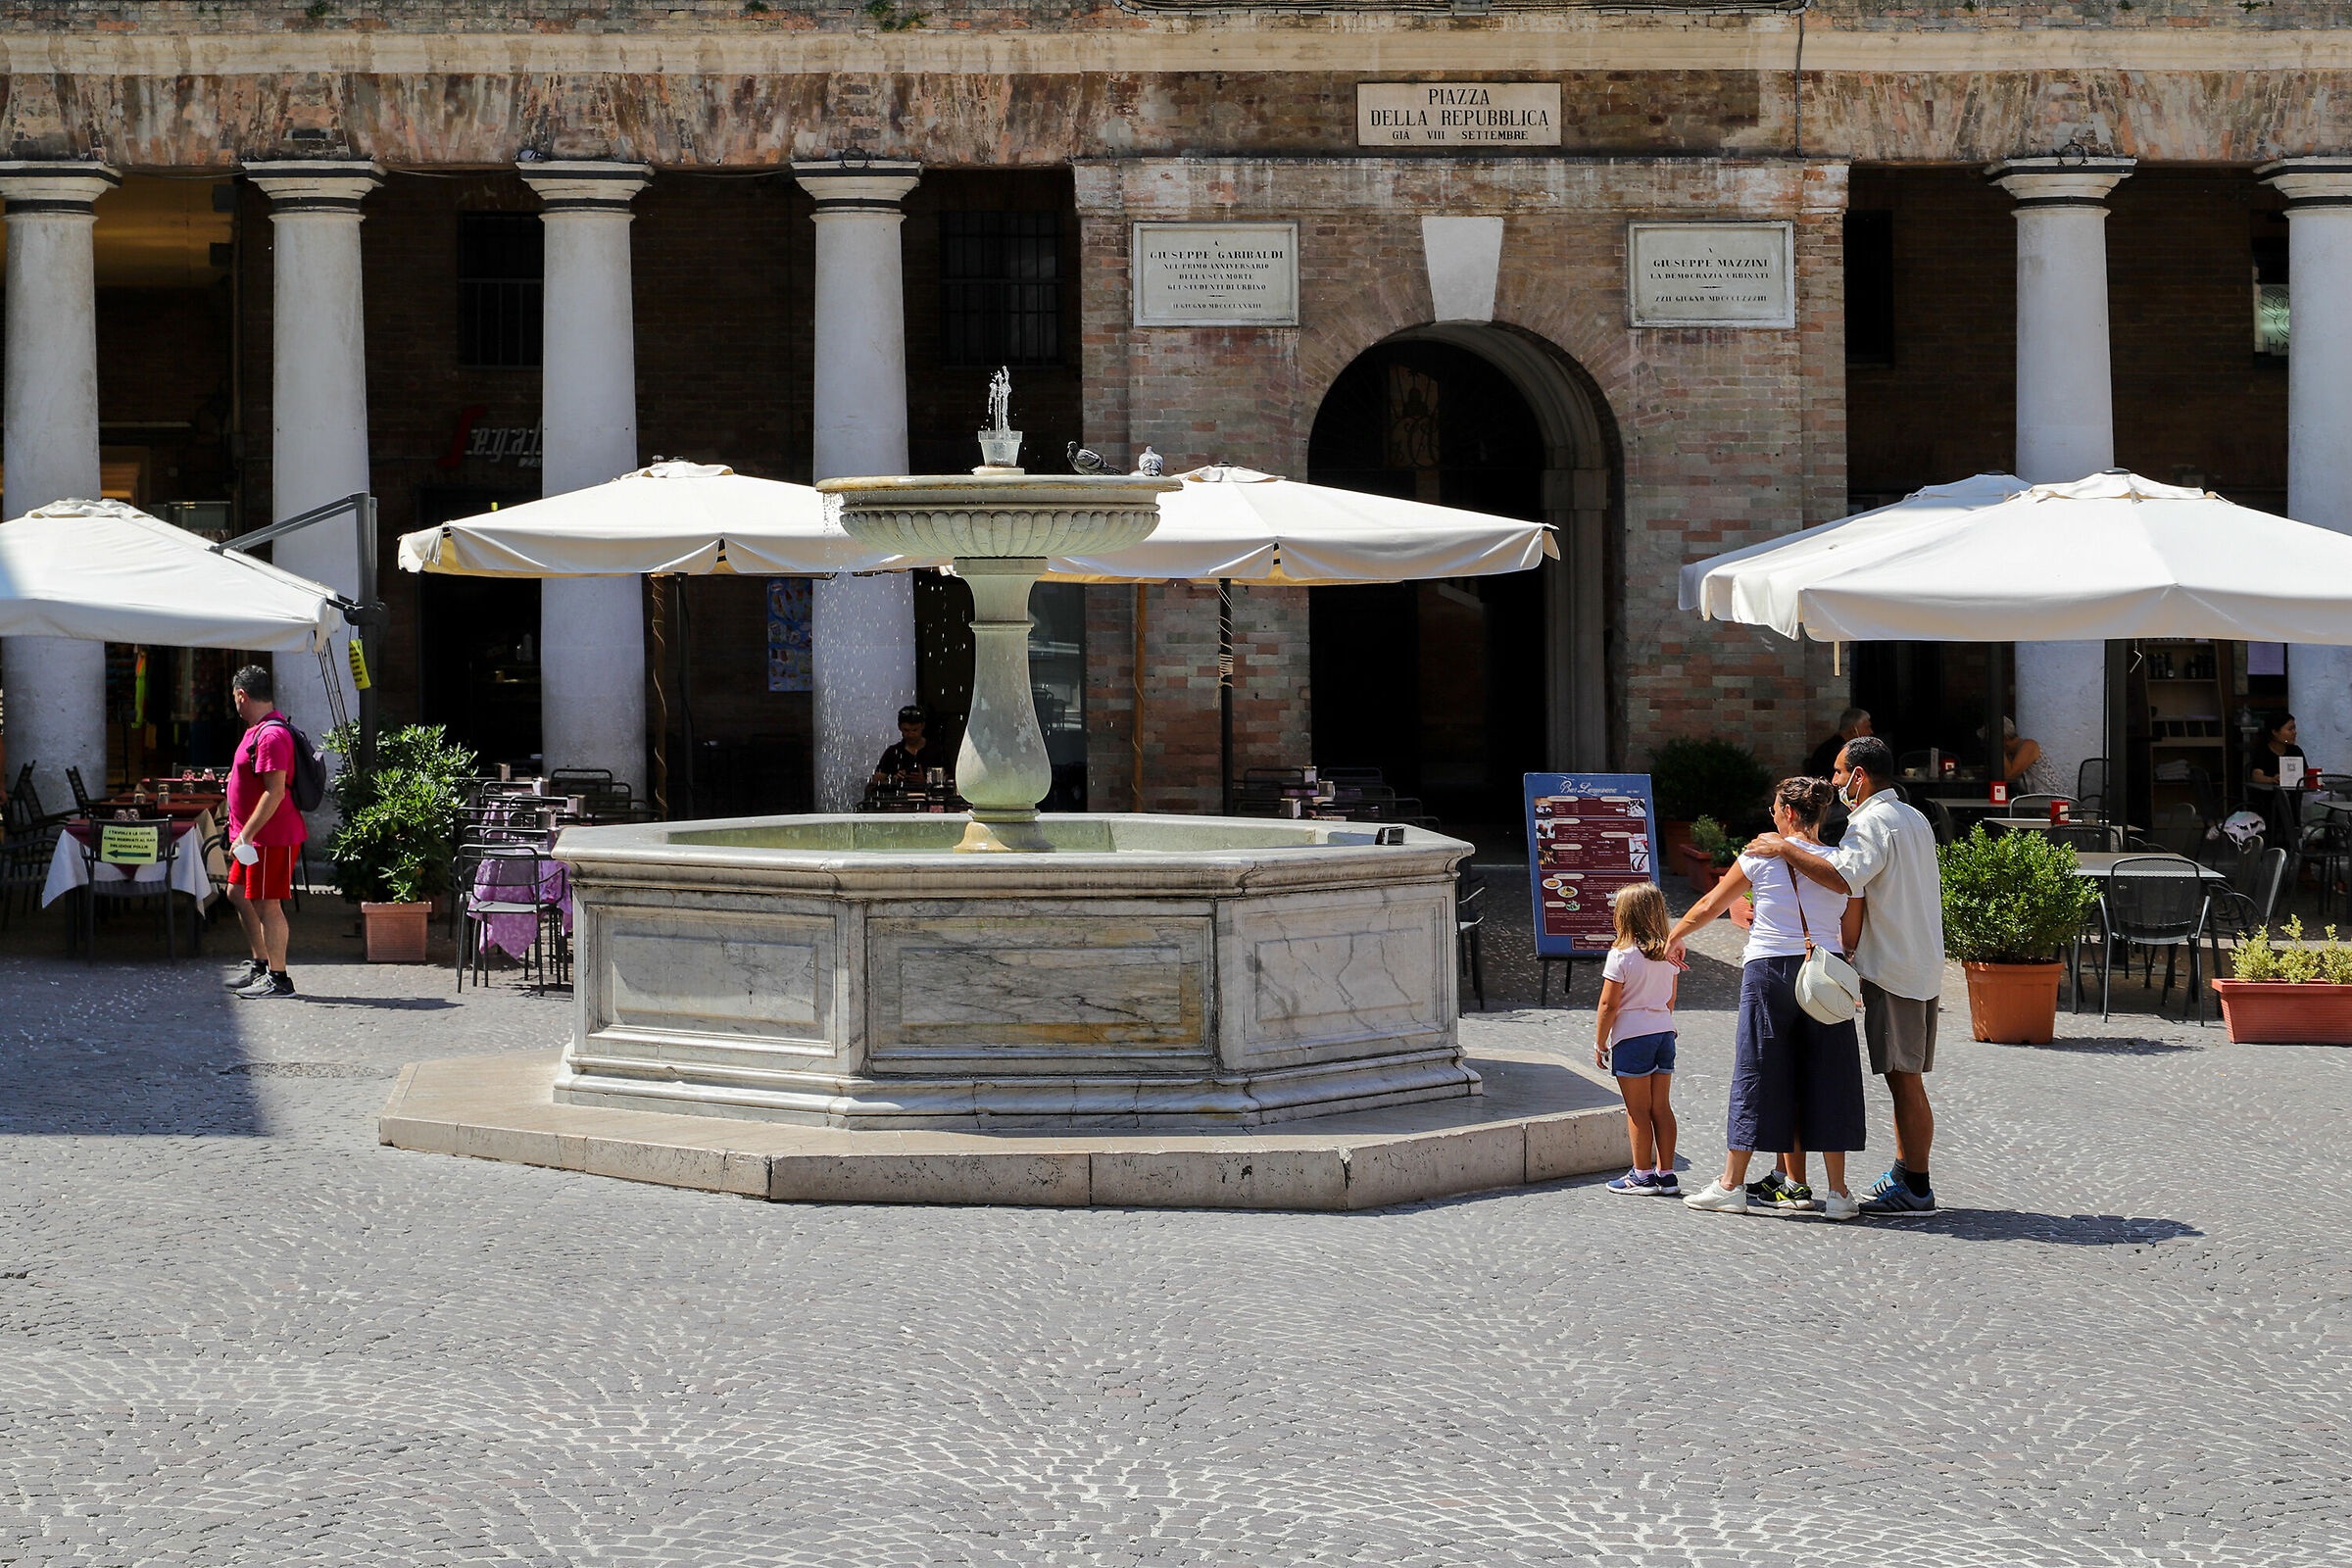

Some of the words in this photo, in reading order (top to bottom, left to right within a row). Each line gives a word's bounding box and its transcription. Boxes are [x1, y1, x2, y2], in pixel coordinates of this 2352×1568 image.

[1428, 88, 1491, 105] PIAZZA
[1370, 109, 1428, 126] DELLA
[1441, 109, 1549, 126] REPUBBLICA
[1427, 130, 1446, 140] VIII
[1461, 130, 1529, 140] SETTEMBRE
[1150, 250, 1211, 260] GIUSEPPE
[1217, 250, 1284, 260] GARIBALDI
[1653, 259, 1713, 268] GIUSEPPE
[1717, 259, 1768, 268] MAZZINI
[1559, 780, 1578, 794] Bar
